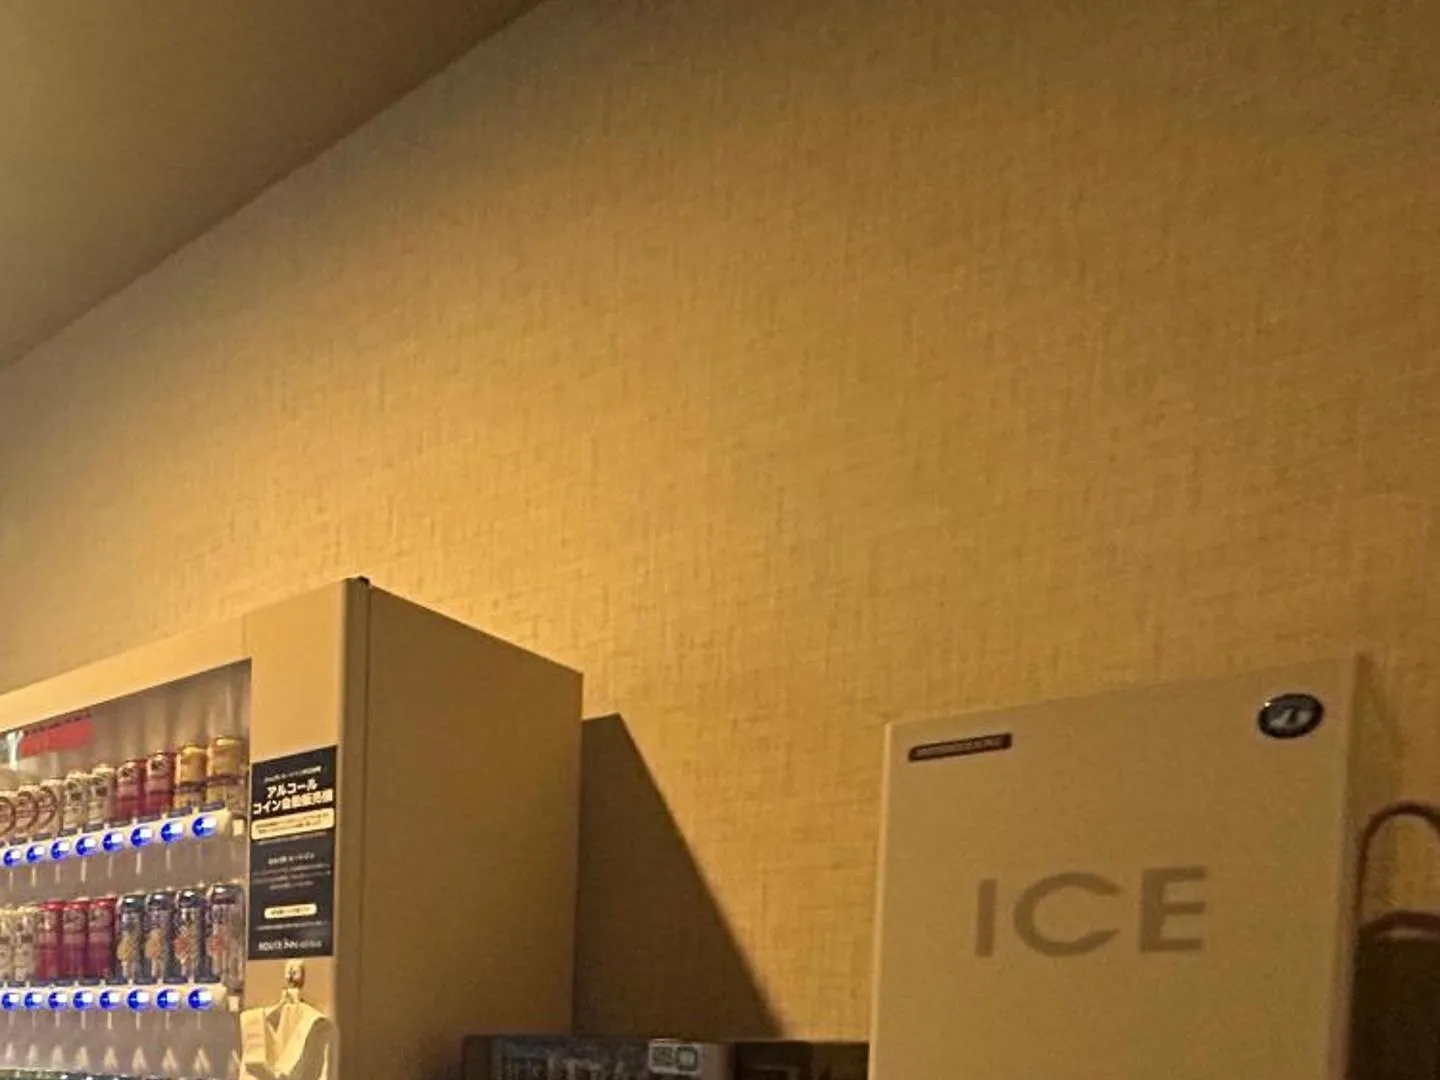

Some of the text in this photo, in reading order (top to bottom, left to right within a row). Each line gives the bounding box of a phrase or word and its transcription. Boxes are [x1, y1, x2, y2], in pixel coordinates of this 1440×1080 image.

[267, 778, 318, 798] アルコール
[975, 866, 1206, 957] ICE
